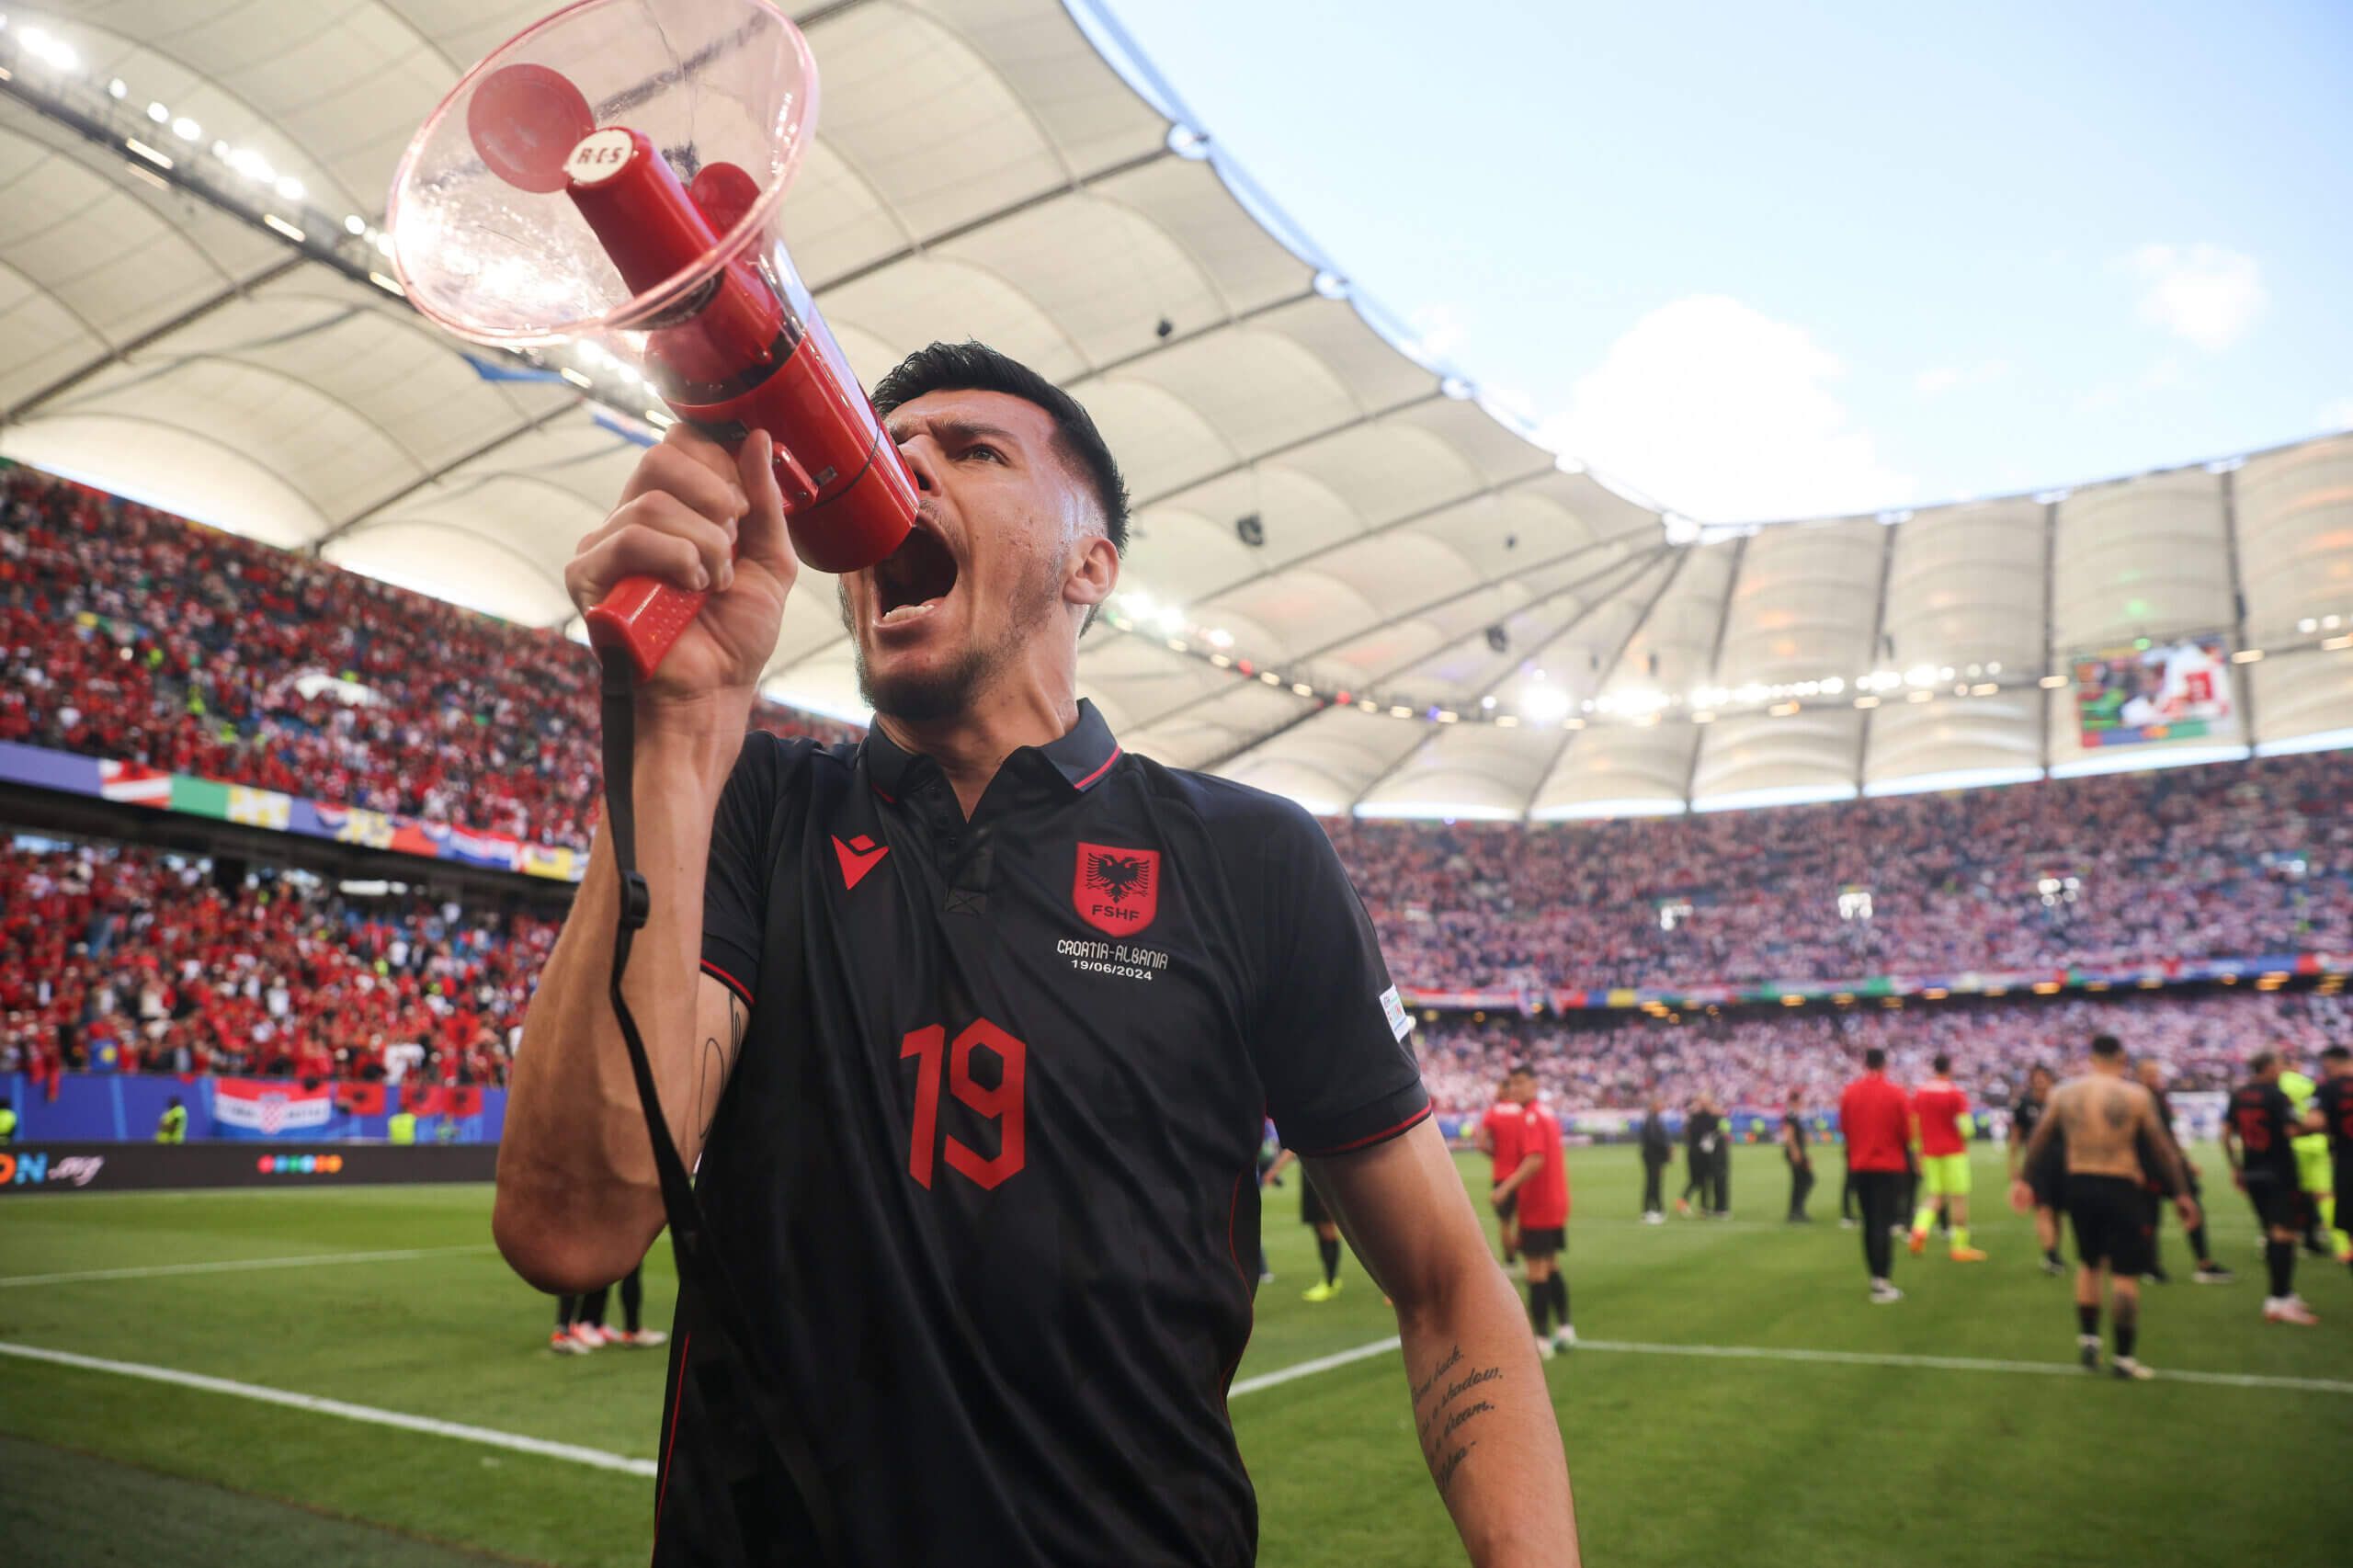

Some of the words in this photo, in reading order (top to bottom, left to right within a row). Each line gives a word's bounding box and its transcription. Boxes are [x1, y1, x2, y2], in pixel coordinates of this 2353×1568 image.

[1092, 904, 1140, 922] FSHF
[1057, 938, 1169, 970] CROATIA-ALBANIA
[1071, 960, 1153, 981] 19/06/2024
[900, 1017, 1027, 1191] 19
